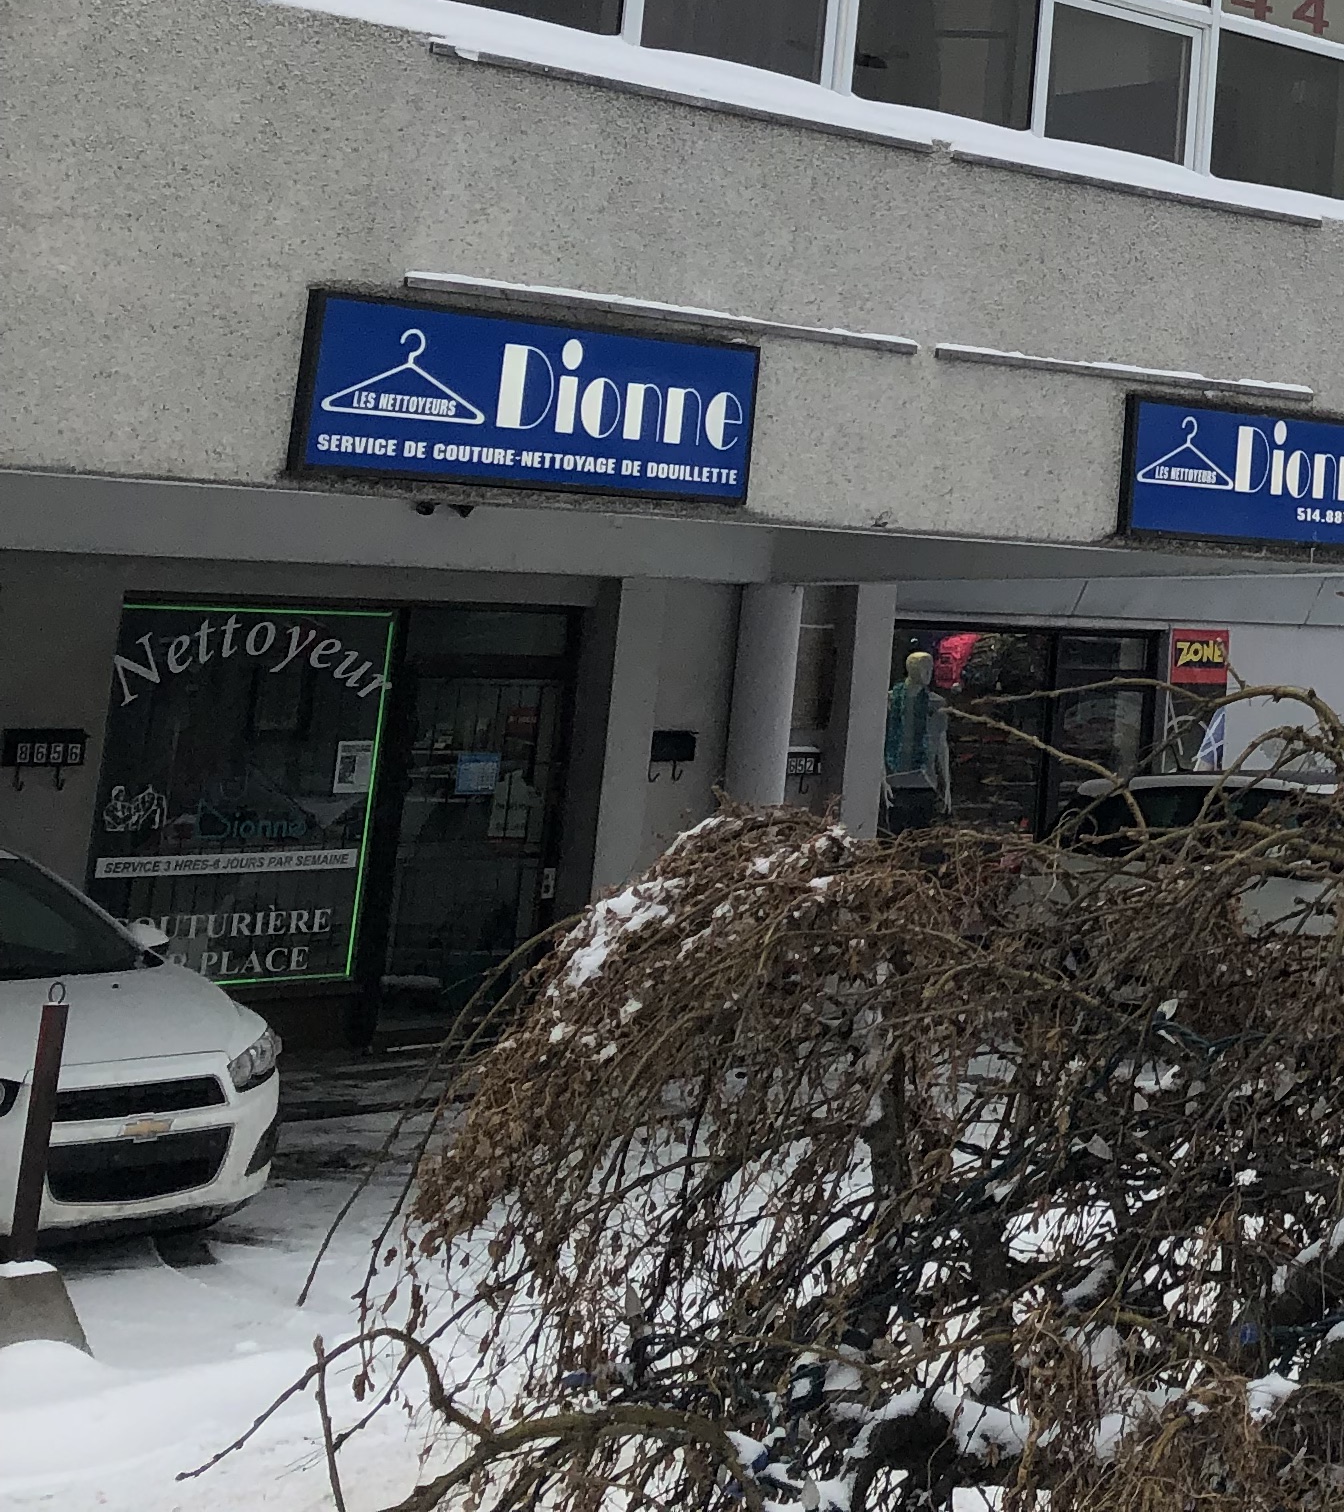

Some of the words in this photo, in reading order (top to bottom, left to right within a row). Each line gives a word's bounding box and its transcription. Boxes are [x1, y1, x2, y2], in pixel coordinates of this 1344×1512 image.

[353, 390, 375, 409] LES
[378, 393, 457, 417] NETTOYEURS
[496, 338, 744, 451] Dionne
[317, 434, 397, 456] SERVICE
[403, 441, 426, 459] DE
[433, 443, 616, 475] COUTURE-NETTOYAGE
[621, 459, 641, 477] DE
[646, 461, 738, 486] DOUILLETTE
[1155, 465, 1169, 480] LES
[1170, 467, 1217, 484] NETTOYEURS
[113, 612, 394, 708] Nettoyeur
[1176, 640, 1224, 667] ZONE
[19, 743, 80, 763] 8656
[103, 861, 160, 875] SERVICE
[163, 861, 171, 872] 3
[222, 857, 265, 870] JOURS
[267, 856, 293, 868] PAR
[296, 853, 350, 866] SEMAINE
[201, 946, 310, 976] PLACE
